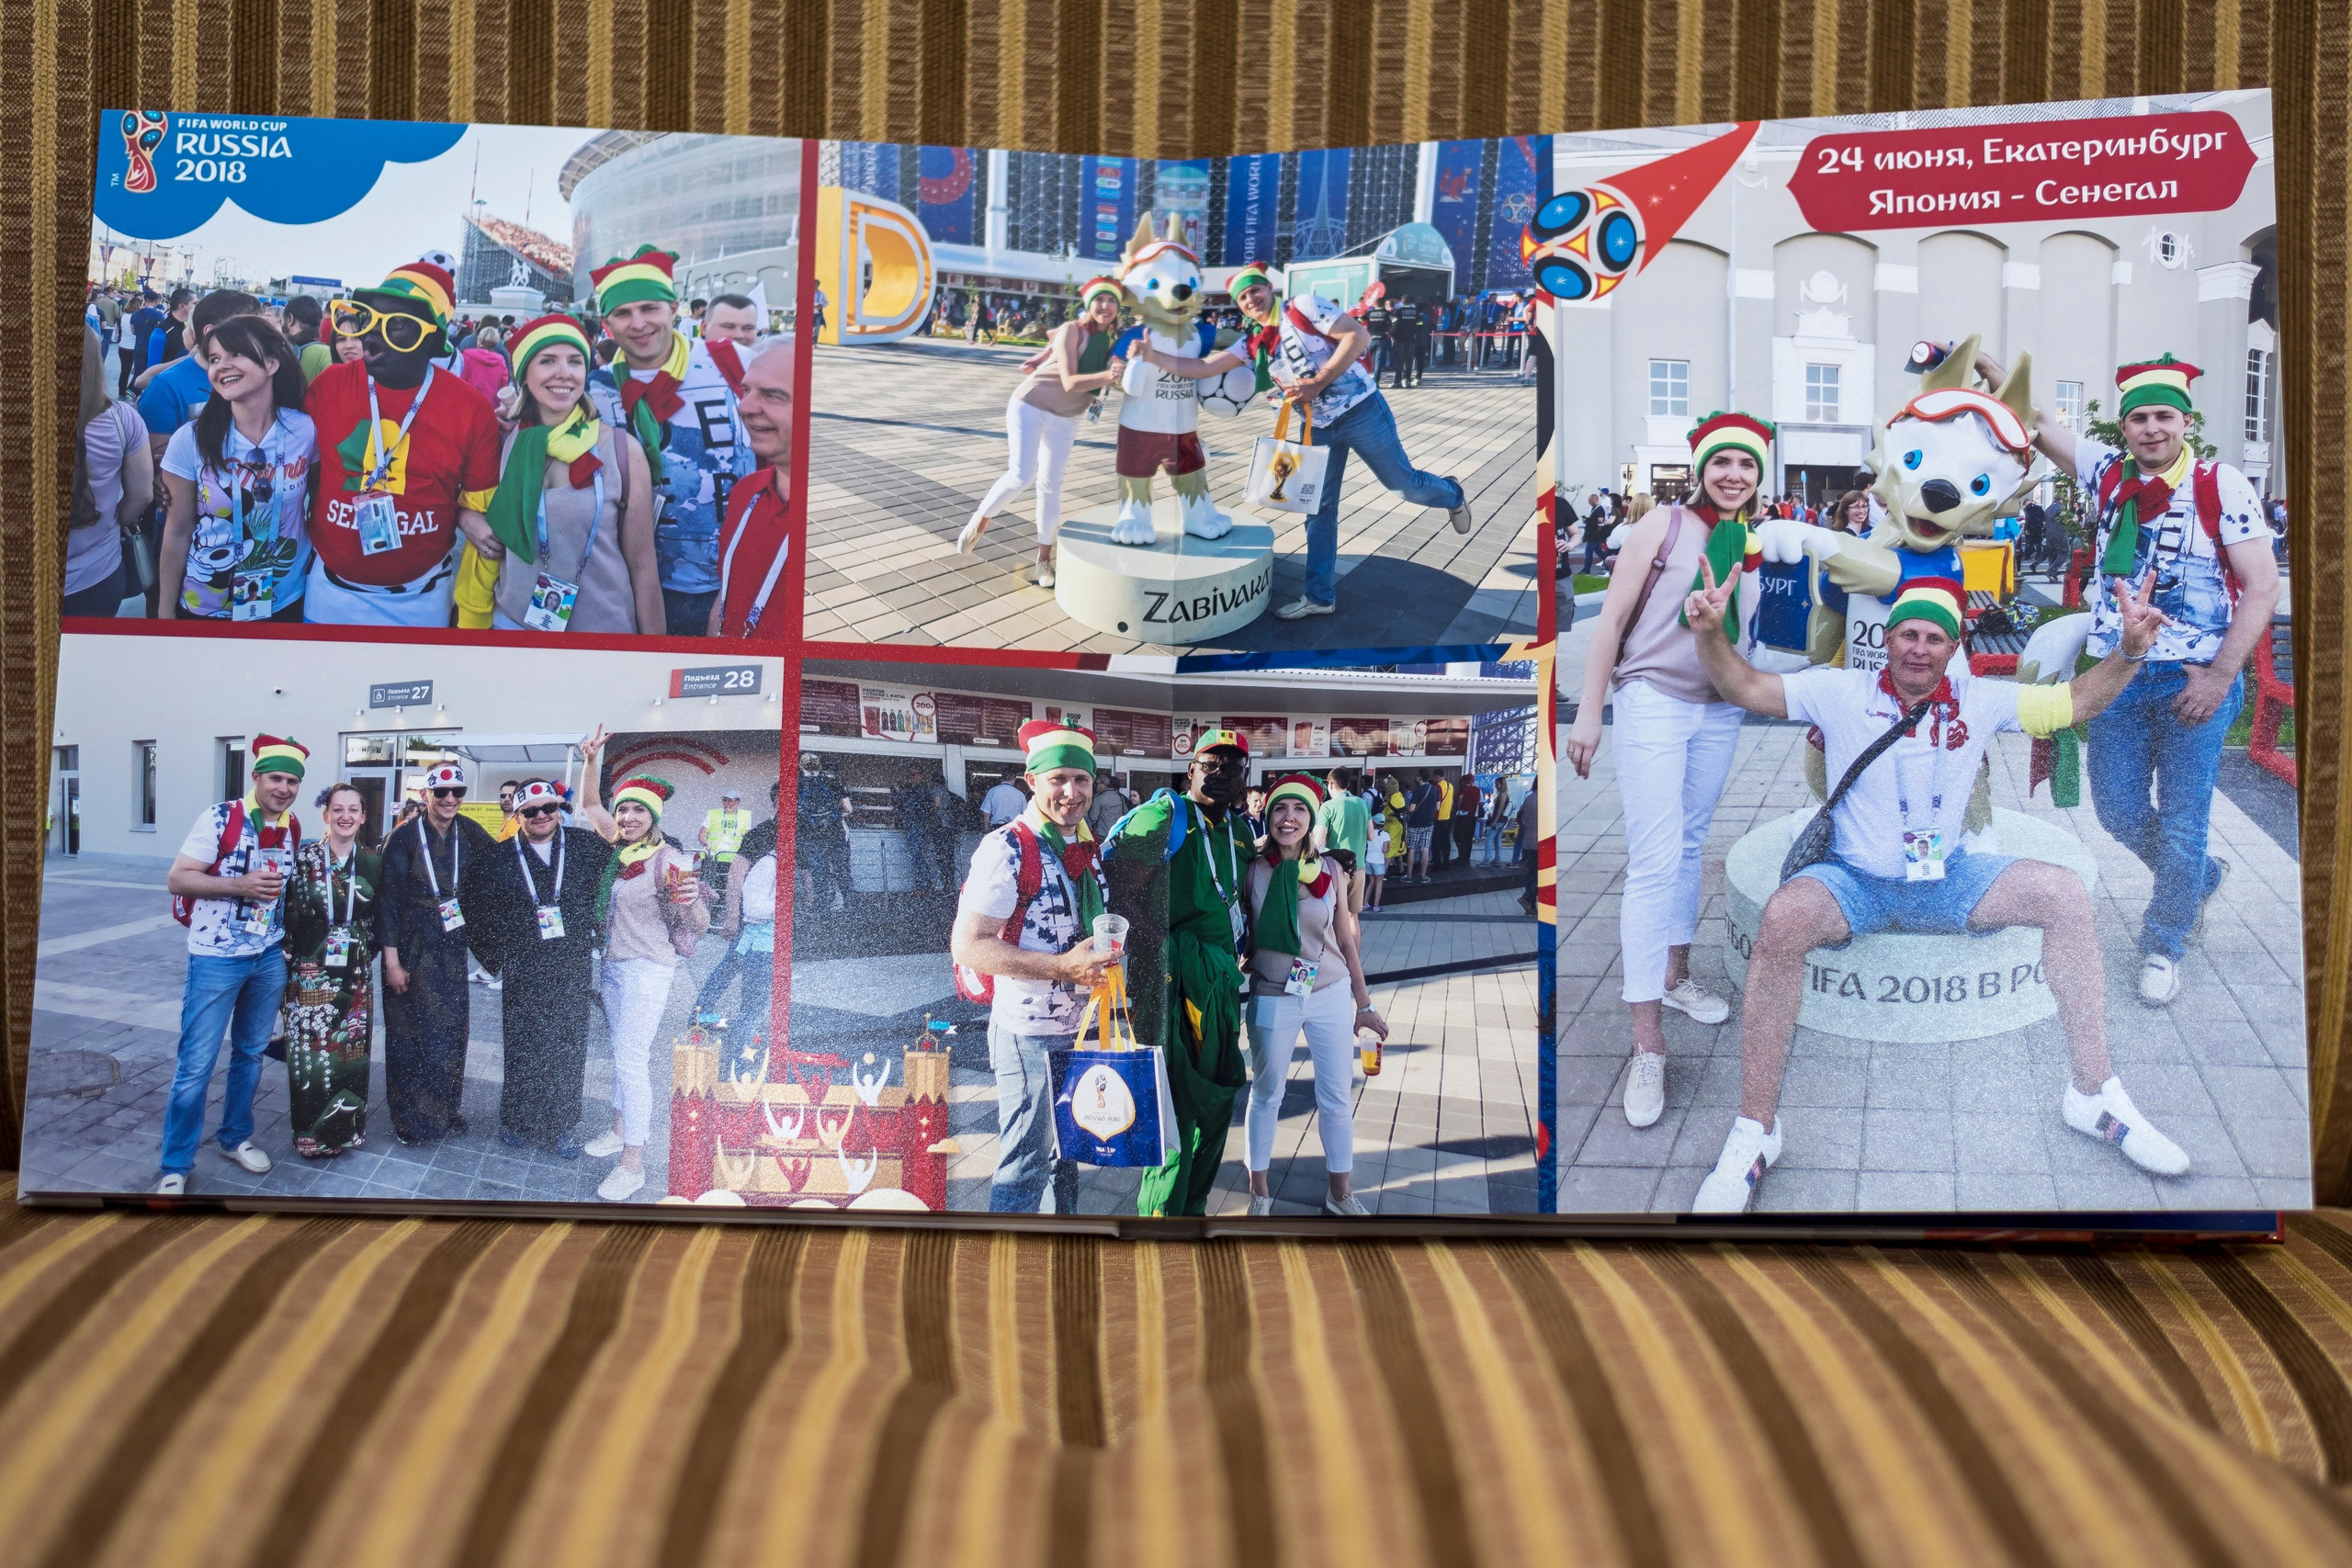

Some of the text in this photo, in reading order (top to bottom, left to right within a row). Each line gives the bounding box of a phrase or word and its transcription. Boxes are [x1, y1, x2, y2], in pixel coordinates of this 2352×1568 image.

[178, 118, 288, 131] FIFA WORLD CUP
[175, 133, 293, 158] RUSSIA
[1817, 128, 2228, 174] 24 июня, Екатеринбург
[110, 173, 119, 187] TM
[175, 159, 247, 184] 2018
[1869, 188, 2001, 215] Япония
[2035, 179, 2177, 206] Сенегал
[1245, 204, 1258, 234] FIFA
[1155, 389, 1194, 400] RUSSIA
[326, 499, 439, 536] SEGAL
[1852, 647, 1866, 657] FIFA
[412, 685, 430, 699] 27
[724, 670, 755, 689] 28
[1877, 975, 1967, 1004] 2018
